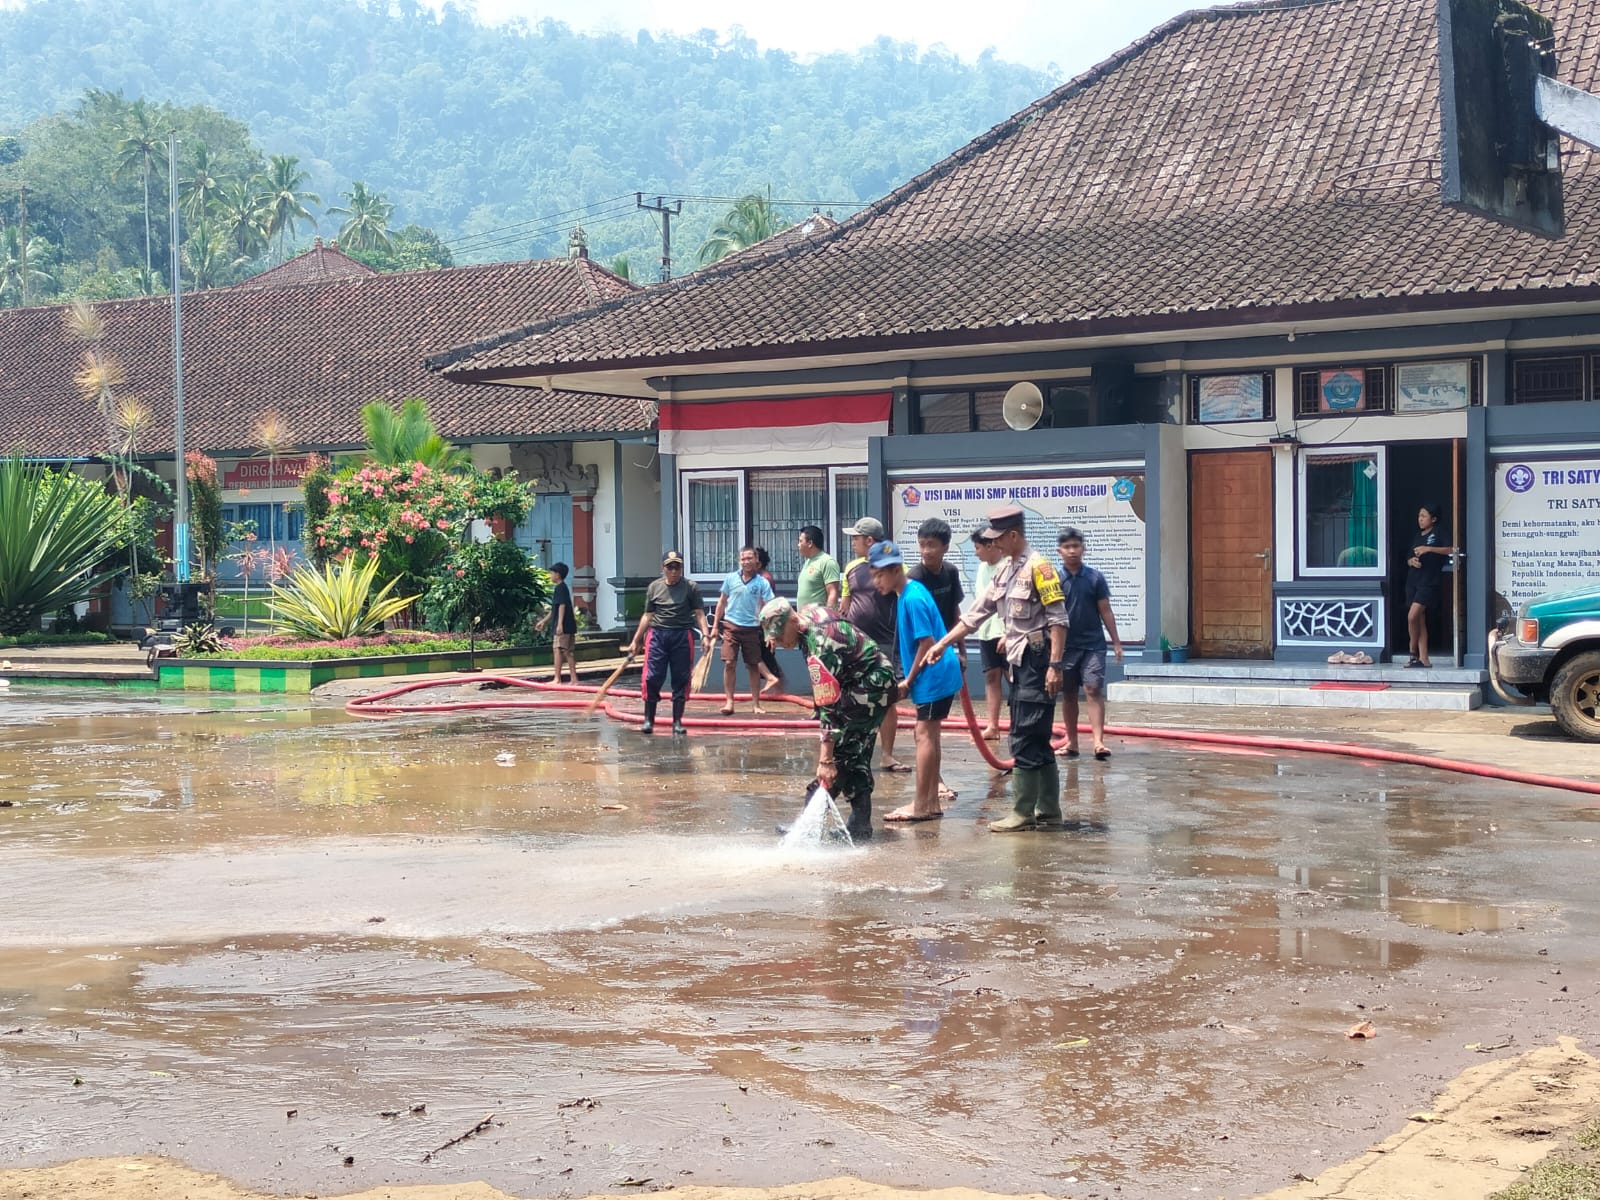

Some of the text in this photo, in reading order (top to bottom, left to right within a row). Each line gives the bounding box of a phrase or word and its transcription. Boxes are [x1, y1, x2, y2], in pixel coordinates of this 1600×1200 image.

[1542, 470, 1564, 485] TRI
[924, 484, 1107, 501] VISI DAN MISI SMP NEGERI 3 BUSUNGBIU
[1067, 505, 1088, 513] MISI
[1547, 499, 1568, 510] TRI
[943, 508, 961, 517] VISI
[1502, 520, 1521, 528] Demi
[1523, 519, 1580, 528] kehormatanku,
[1581, 518, 1595, 526] aku
[1502, 529, 1580, 538] bersungguh-sungguh:
[1511, 550, 1558, 560] Menjalankan
[1511, 560, 1535, 568] Tuhan
[1536, 560, 1555, 569] Yang
[1557, 559, 1577, 567] Maha
[1579, 559, 1595, 568] Esa,
[1511, 570, 1545, 580] Republik
[1546, 570, 1585, 579] Indonesia,
[1511, 580, 1548, 588] Pancasila.
